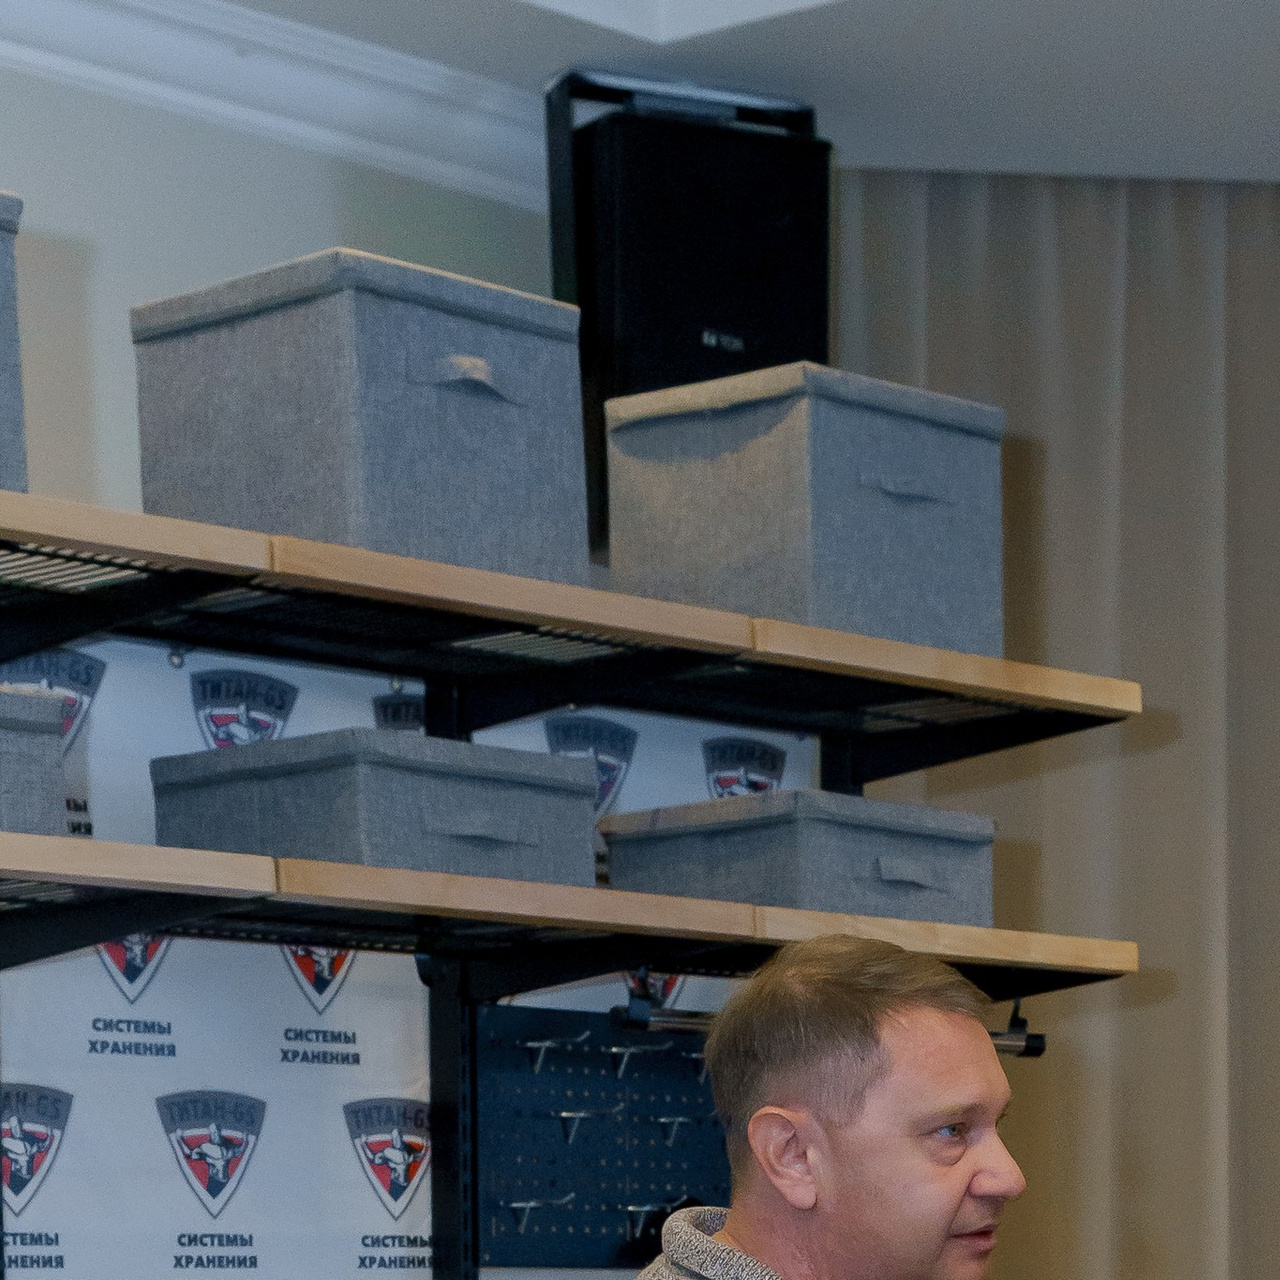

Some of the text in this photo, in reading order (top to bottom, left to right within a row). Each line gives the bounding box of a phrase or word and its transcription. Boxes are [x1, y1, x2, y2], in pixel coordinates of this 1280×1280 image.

[92, 1018, 171, 1035] СИСТЕМЫ
[284, 1028, 357, 1044] СИСТЕМЫ
[89, 1040, 176, 1057] ХРАНЕНИЯ
[280, 1048, 360, 1065] ХРАНЕНИЯ
[163, 1100, 257, 1128] ТИТАН-GS
[2, 1232, 59, 1247] СТЕМЫ
[177, 1233, 253, 1247] СИСТЕМЫ
[5, 1255, 64, 1269] НЕНИЯ
[173, 1254, 258, 1269] ХРАНЕНИЯ
